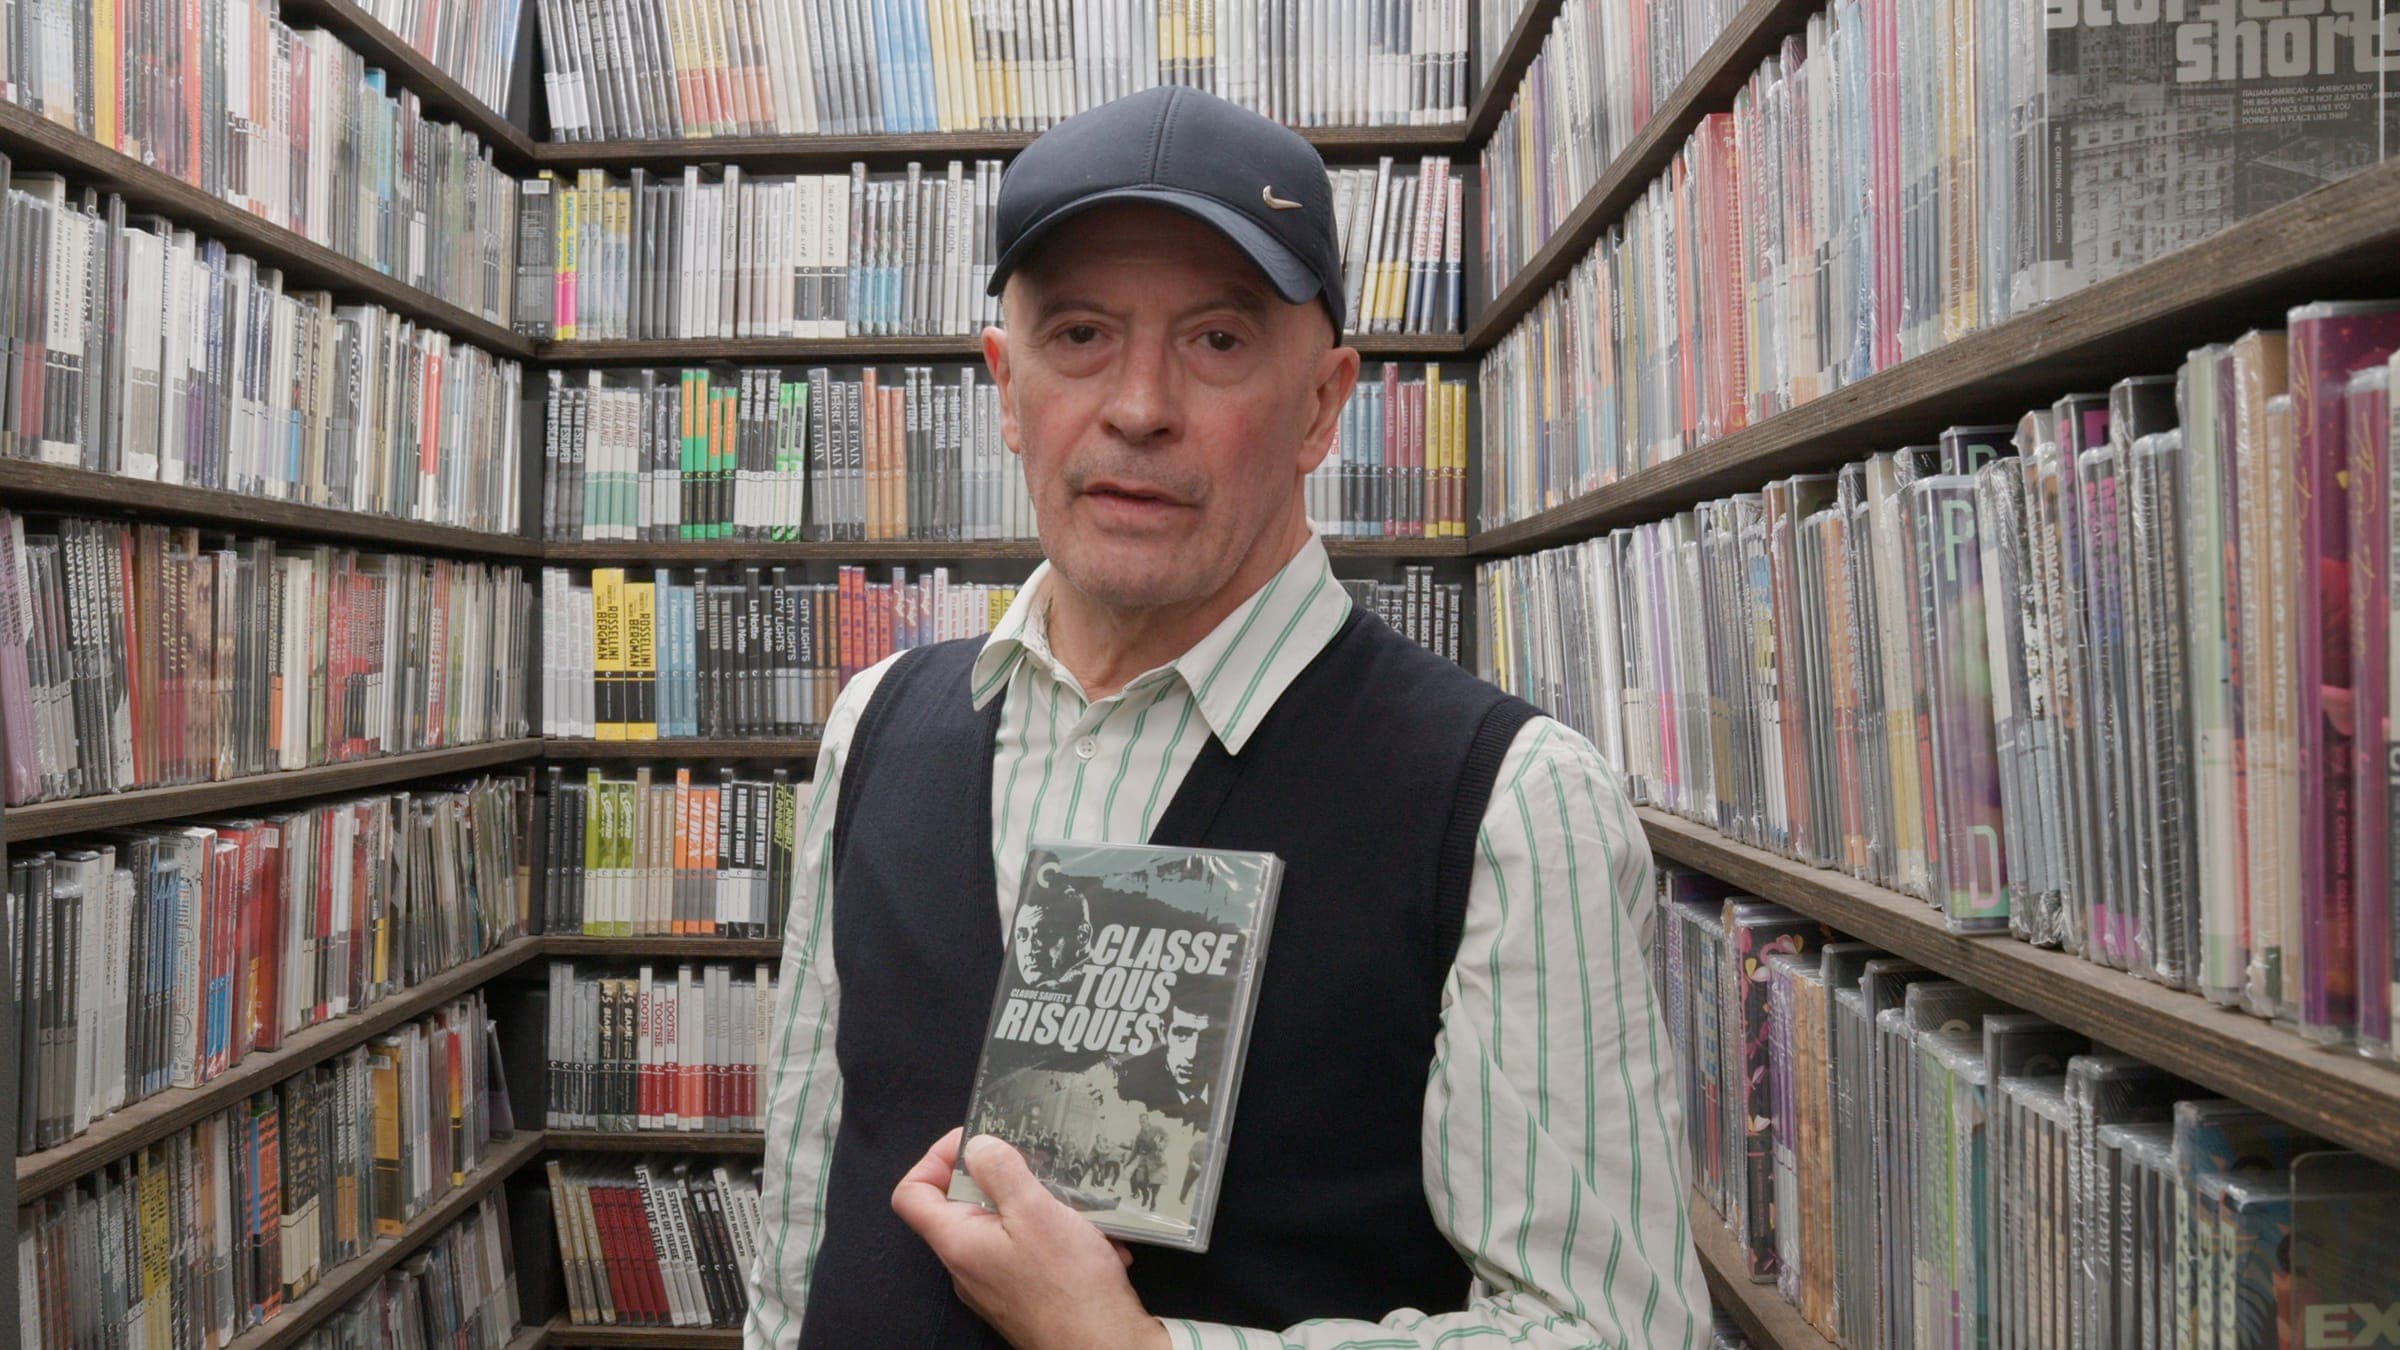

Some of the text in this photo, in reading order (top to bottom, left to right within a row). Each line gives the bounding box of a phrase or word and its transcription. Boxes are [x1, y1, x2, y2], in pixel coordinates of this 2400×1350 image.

[2334, 102, 2351, 110] YOU
[2357, 83, 2373, 91] BOY
[2055, 145, 2063, 189] CRITERION
[2055, 192, 2064, 244] COLLECTION
[812, 379, 823, 421] PIERRE
[831, 384, 842, 426] PIERRE
[848, 384, 860, 426] PIERRE
[547, 399, 558, 457] MAN ESCAPED
[560, 406, 571, 463] MAN ESCAPED
[574, 406, 585, 463] MAN ESCAPED
[614, 400, 625, 448] BADLANDS
[626, 401, 637, 448] BADLANDS
[2191, 449, 2210, 640] AFTER LIFE
[65, 535, 80, 646] YOUTH BEAST
[74, 535, 90, 647] YOUTH BEAST
[84, 535, 99, 646] FIGHTING ELEGY
[97, 535, 110, 644] FIGHTING ELEGY
[162, 541, 170, 649] NIGHT CITY
[1407, 593, 1416, 602] IN
[1421, 593, 1431, 602] IN
[2160, 470, 2184, 710] WORKING GIRLS
[597, 612, 607, 660] BERGMAN
[607, 605, 619, 660] ROSSELLINI
[640, 613, 651, 667] ROSSELLINI
[738, 616, 746, 654] La Notte
[750, 599, 759, 639] La Notte
[764, 614, 772, 652] La Notte
[774, 588, 785, 652] CITY LIGHTS
[786, 597, 796, 661] CITY LIGHTS
[800, 598, 810, 662] CITY LIGHTS
[1421, 619, 1431, 641] BLOCK
[1450, 613, 1459, 622] IN
[629, 619, 639, 667] BERGMAN
[2274, 631, 2289, 720] NATION
[720, 790, 730, 810] HARD
[720, 812, 730, 834] DAY'S
[736, 795, 747, 816] HARD
[755, 797, 767, 818] HARD
[774, 783, 784, 847] SCANNERS
[783, 791, 794, 852] SCANNERS
[720, 835, 730, 858] NIGHT
[736, 817, 747, 839] DAY'S
[755, 819, 767, 841] DAY'S
[736, 840, 747, 864] NIGHT
[755, 842, 767, 866] NIGHT
[1092, 924, 1239, 976] CLASSE
[1011, 988, 1039, 1000] CLAUDE
[1075, 964, 1177, 1014] TOUS
[641, 991, 650, 1037] TOOTSIE
[655, 1001, 663, 1048] TOOTSIE
[667, 999, 675, 1045] TOOTSIE
[994, 998, 1160, 1056] RISQUES
[336, 1125, 346, 1164] ANGEL
[637, 1172, 667, 1261] STATE OF SIEGE
[655, 1190, 682, 1261] STATE OF SIEGE
[667, 1191, 693, 1262] STATE OF SIEGE
[723, 1188, 736, 1221] MASTER
[732, 1223, 745, 1257] BUILDER
[2305, 1302, 2400, 1349] EX
